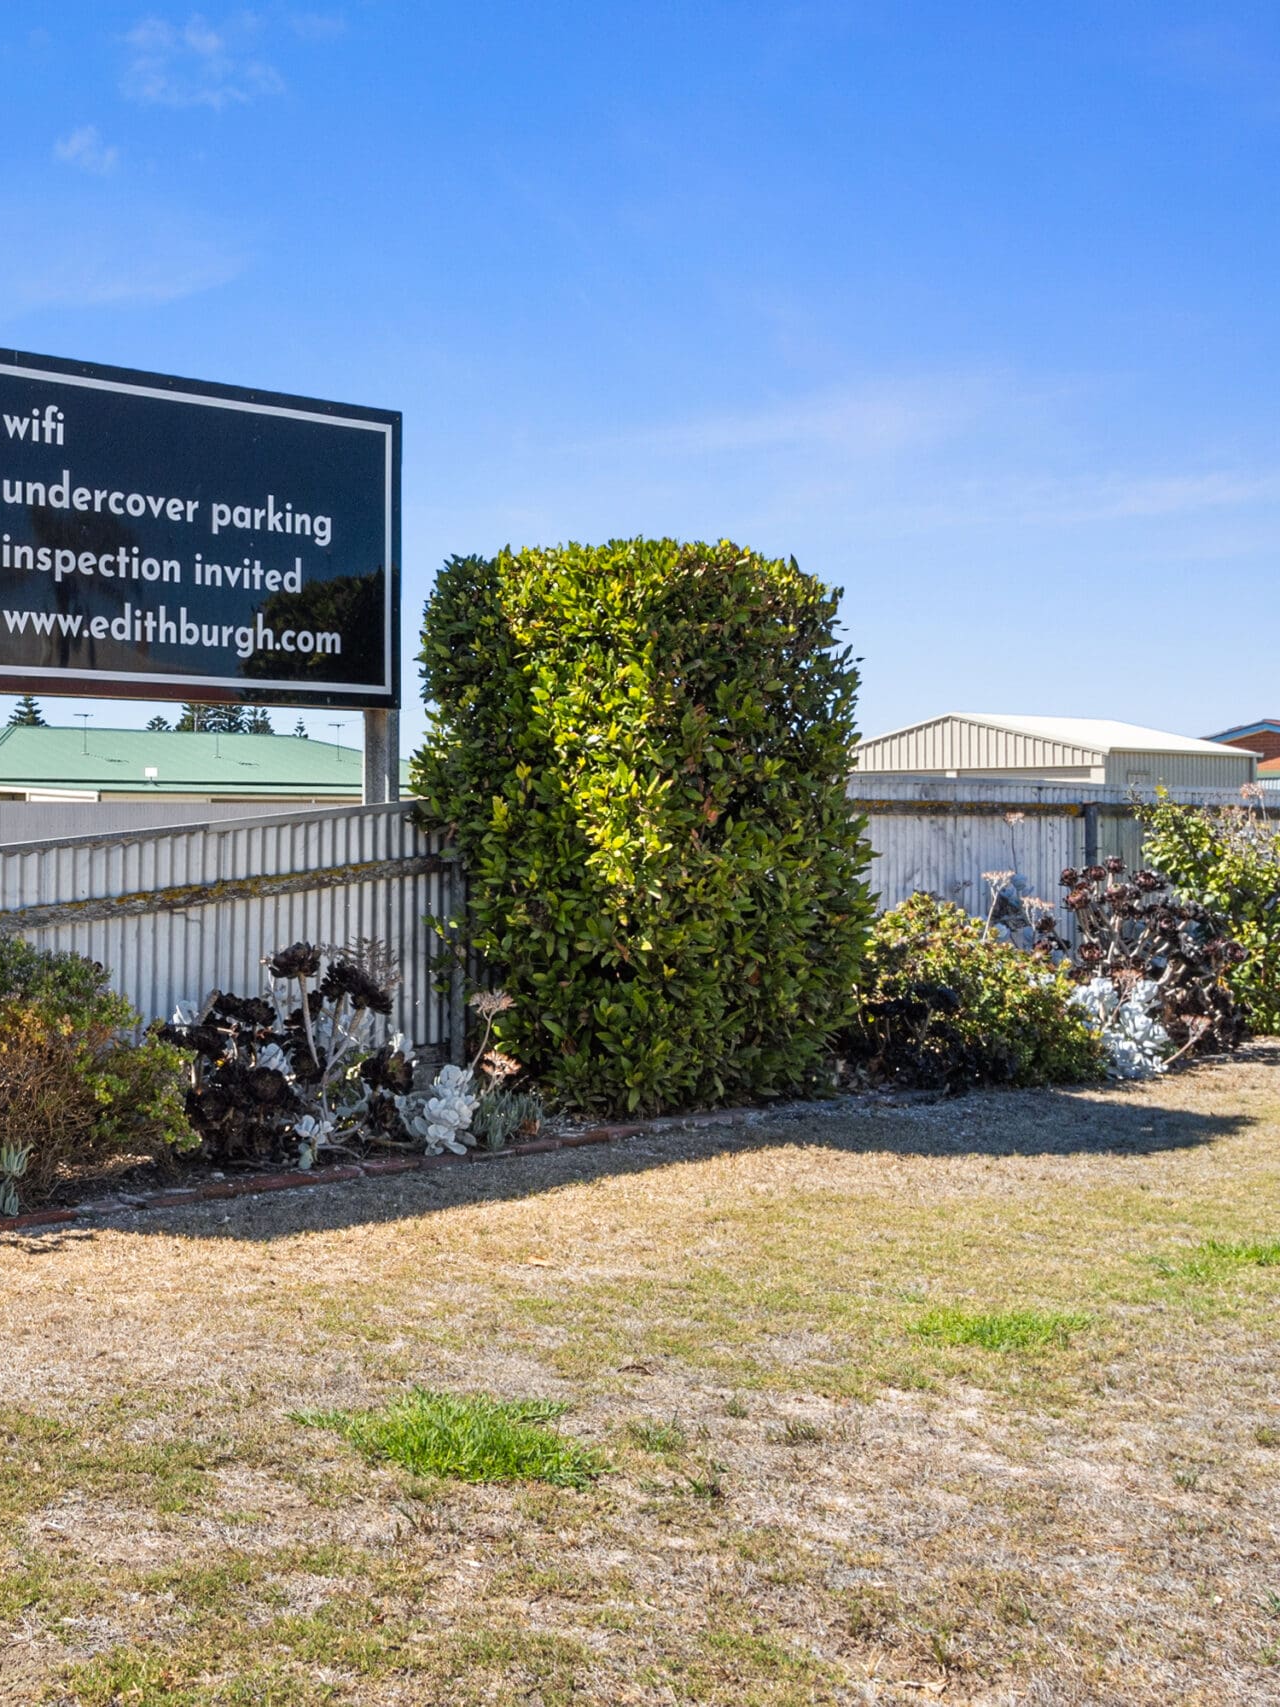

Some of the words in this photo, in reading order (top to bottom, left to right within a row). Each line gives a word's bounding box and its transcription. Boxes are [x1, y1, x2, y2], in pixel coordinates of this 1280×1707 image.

[3, 405, 65, 445] wifi
[2, 470, 199, 522] undercover
[212, 495, 332, 546] parking
[2, 534, 181, 583] inspection
[195, 553, 302, 594] invited
[3, 603, 341, 657] www.edithburgh.com
